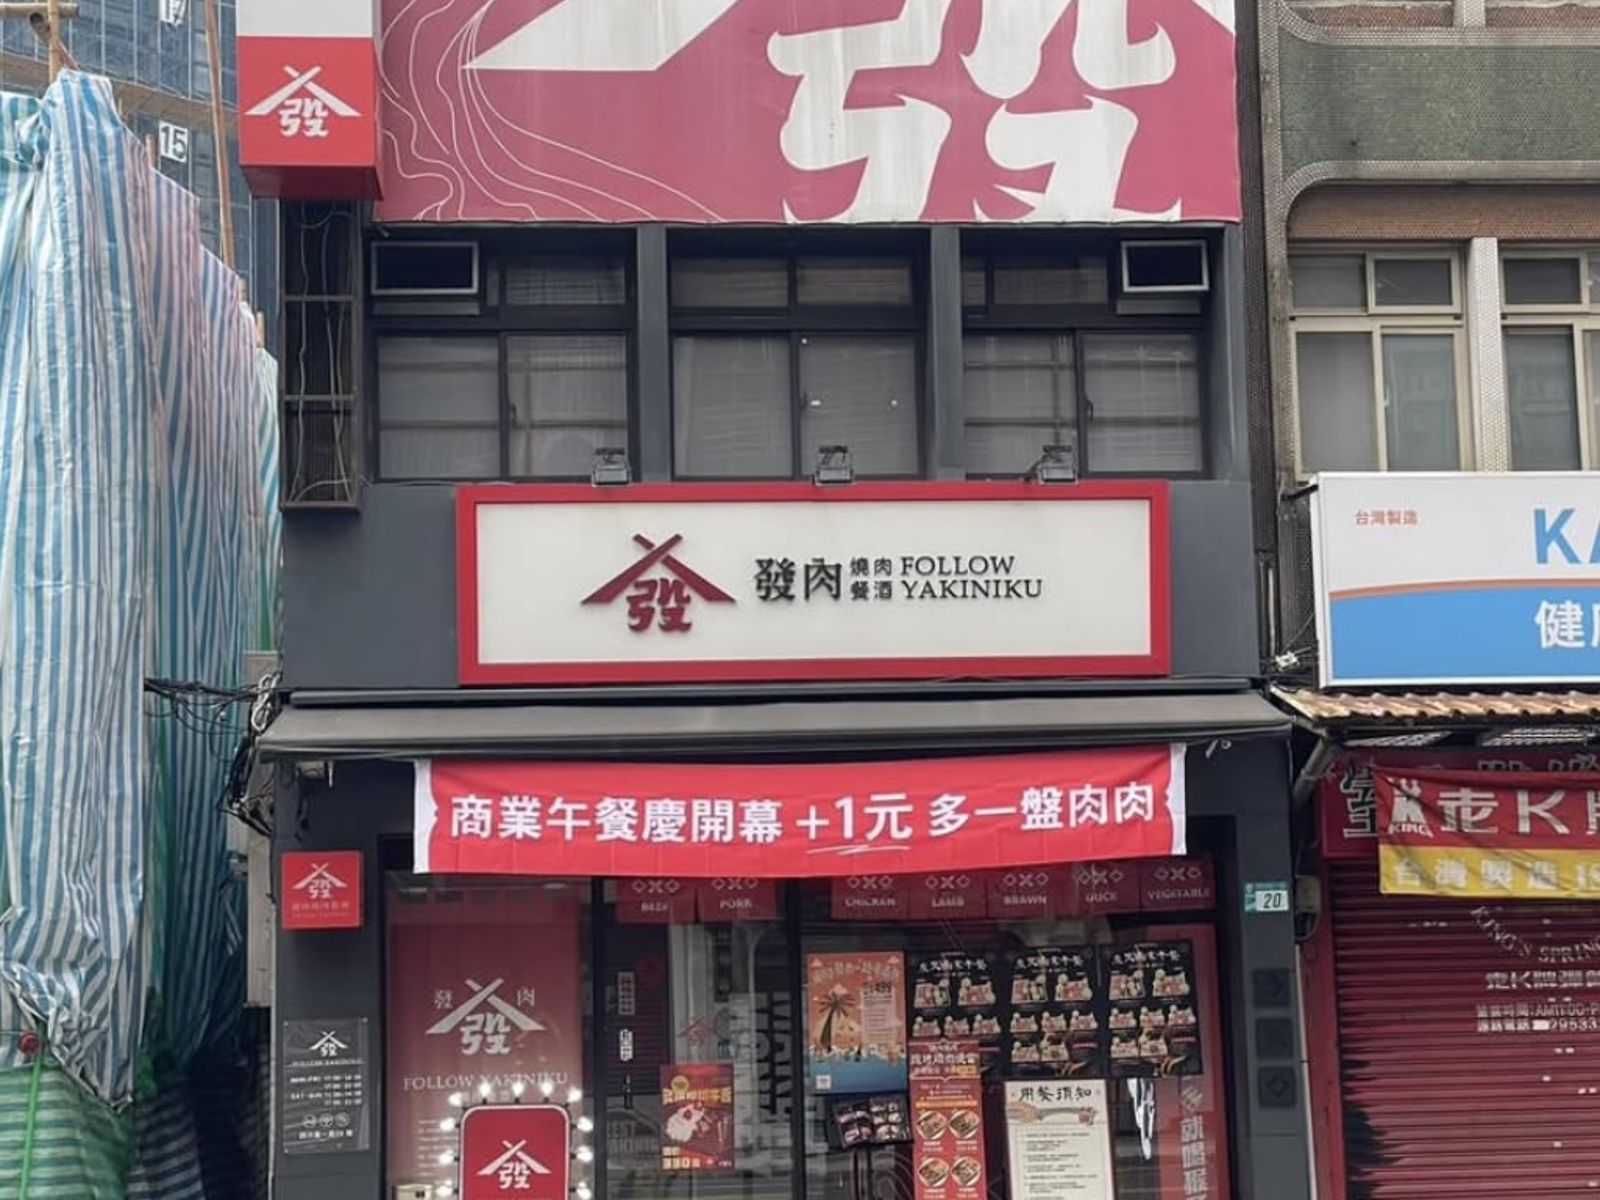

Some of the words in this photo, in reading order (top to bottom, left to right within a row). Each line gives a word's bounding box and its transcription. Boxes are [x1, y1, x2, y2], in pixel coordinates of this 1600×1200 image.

[161, 124, 187, 160] 15
[1355, 509, 1418, 526] 台灣製造
[1534, 508, 1600, 564] K
[850, 556, 892, 577] 燒肉
[900, 555, 1015, 576] FOLLOW
[753, 557, 843, 602] 發肉
[900, 579, 1042, 599] YAKINIKU
[850, 580, 892, 600] 餐酒
[1534, 600, 1600, 649] 健
[450, 794, 784, 844] 商業午餐慶開幕
[796, 793, 914, 842] +1元
[928, 780, 1155, 838] 多一盤肉肉
[1437, 788, 1600, 836] 老K
[1387, 822, 1434, 839] KING
[1394, 858, 1558, 890] 台灣製造
[844, 897, 896, 908] CHICKEN
[931, 896, 965, 908] LAMB
[1147, 887, 1211, 900] VEGETABLE
[1263, 892, 1282, 909] 20
[1550, 1016, 1600, 1032] 29533
[402, 1074, 473, 1091] FOLLOW
[480, 1071, 569, 1087] YAKINIKU
[1018, 1085, 1093, 1103] 用餐須知
